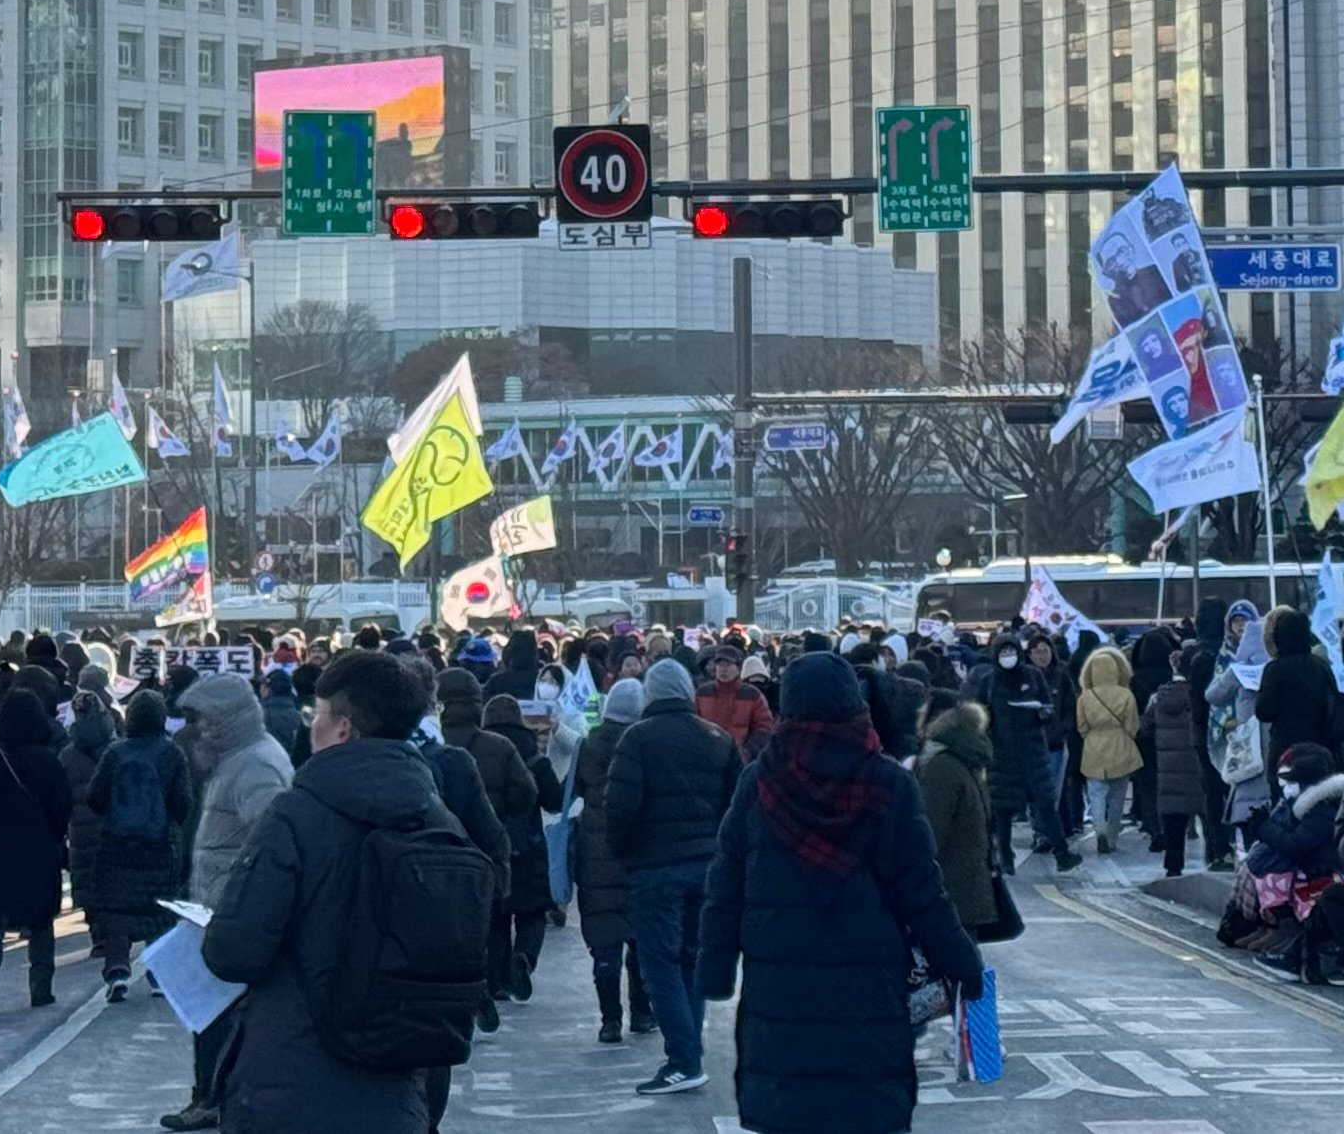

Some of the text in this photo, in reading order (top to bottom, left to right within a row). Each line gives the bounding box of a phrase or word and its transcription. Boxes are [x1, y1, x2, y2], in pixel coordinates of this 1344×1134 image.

[580, 154, 626, 193] 40
[562, 224, 647, 247] 도심부
[1248, 249, 1334, 271] 세종대로
[1239, 272, 1334, 288] Sejong-daero
